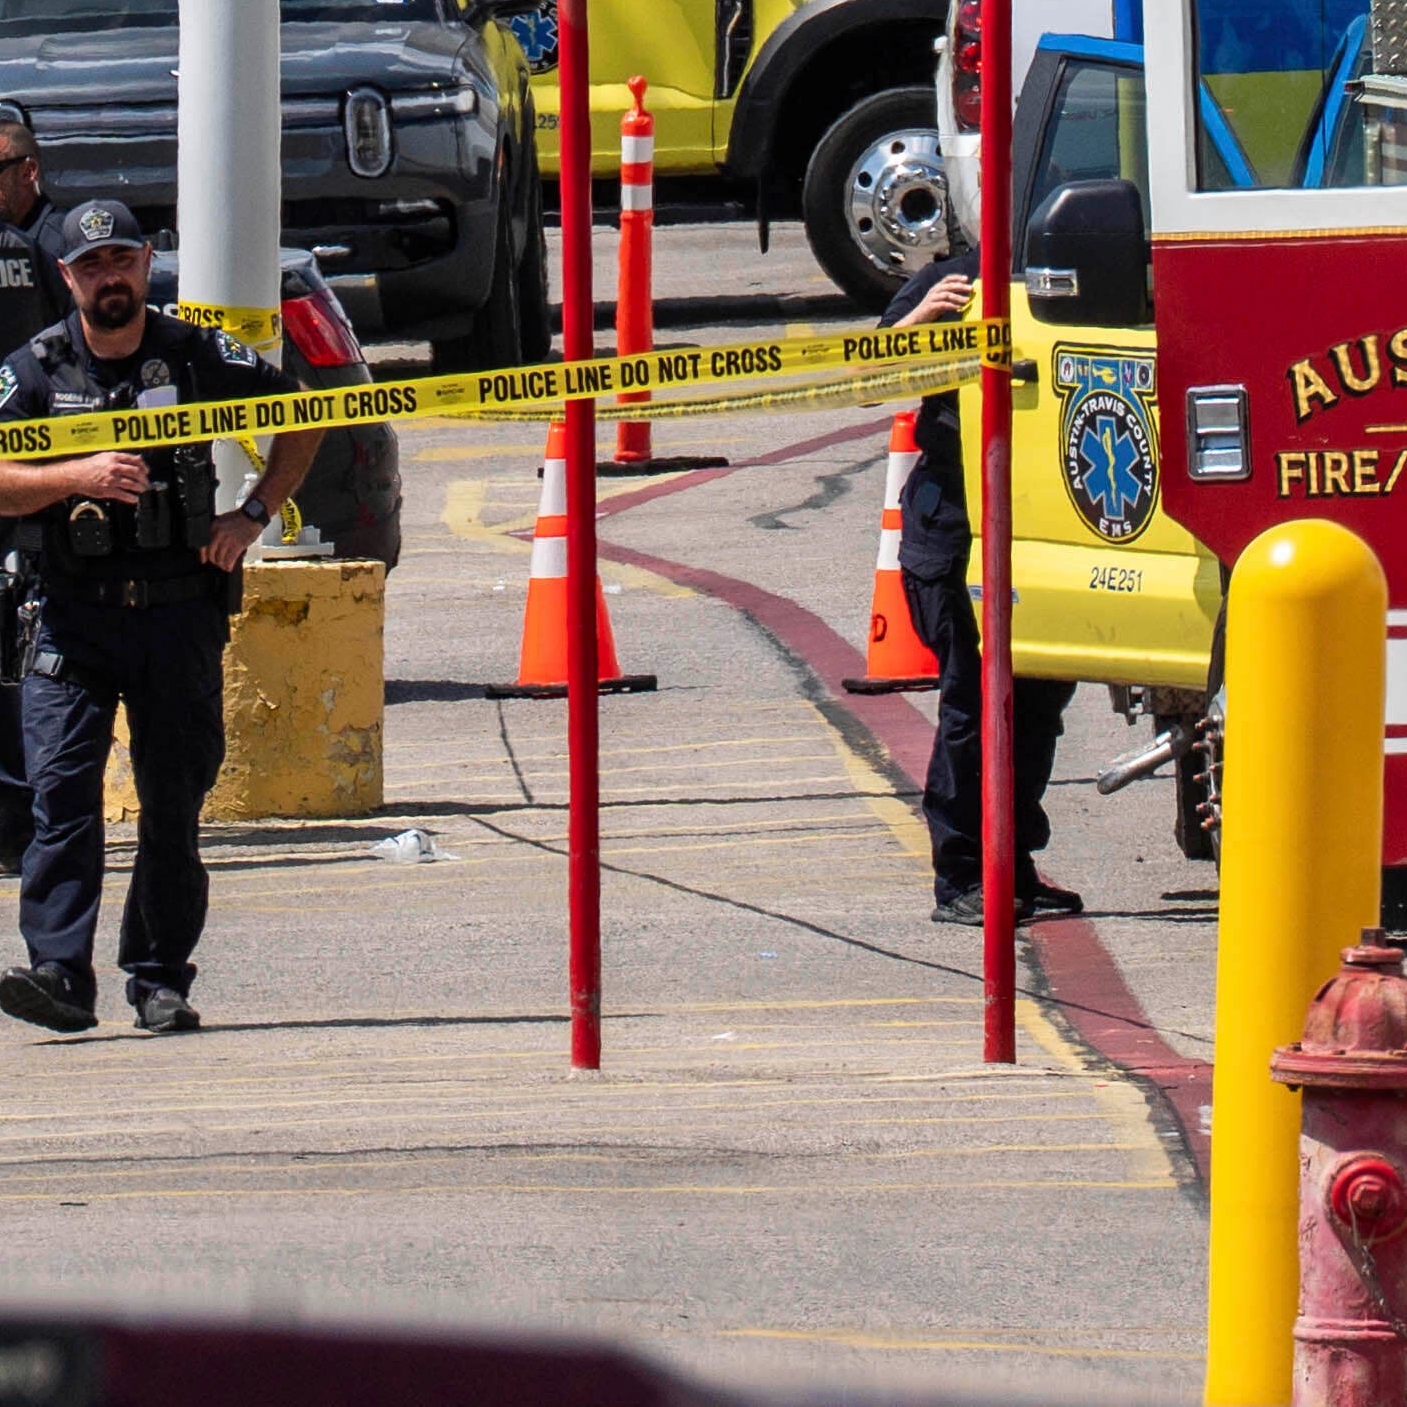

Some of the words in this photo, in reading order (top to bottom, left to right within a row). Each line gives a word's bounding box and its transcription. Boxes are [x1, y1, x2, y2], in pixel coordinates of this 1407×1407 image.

[844, 331, 921, 361] POLICE
[929, 327, 977, 353] LINE
[479, 370, 558, 403] POLICE
[565, 364, 613, 393] LINE
[621, 360, 649, 387] DO
[658, 353, 702, 381] NOT
[711, 345, 782, 376] CROSS
[113, 411, 191, 442] POLICE
[200, 404, 247, 433] LINE
[257, 400, 285, 428] DO
[294, 396, 336, 423] NOT
[344, 387, 417, 418] CROSS
[1069, 396, 1125, 490] AUSTIN-TRAVIS
[1126, 414, 1152, 497] COUNTY
[1099, 518, 1132, 537] EMS
[1089, 567, 1143, 592] 24E251
